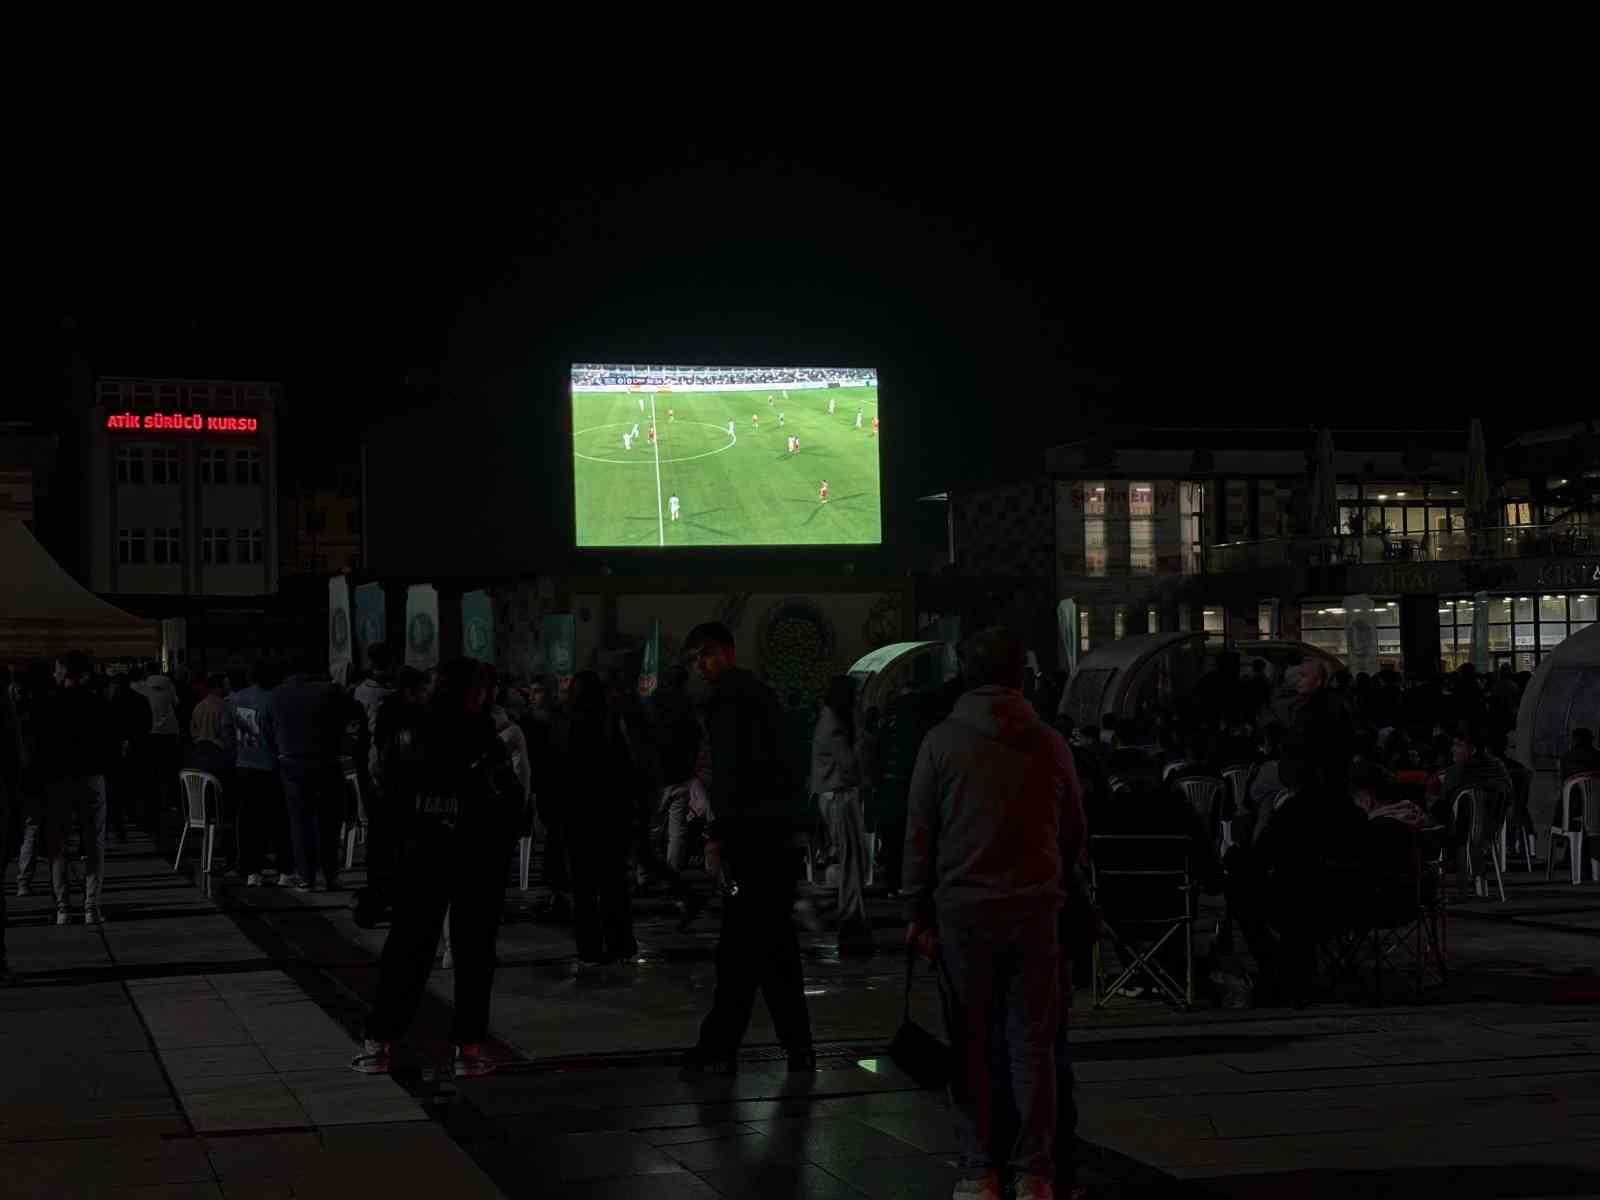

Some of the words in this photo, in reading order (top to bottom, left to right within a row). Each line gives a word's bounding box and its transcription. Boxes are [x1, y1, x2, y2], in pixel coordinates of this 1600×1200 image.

[107, 412, 141, 429] ATİK
[143, 412, 203, 430] SÜRÜCÜ
[207, 416, 258, 431] KURSU
